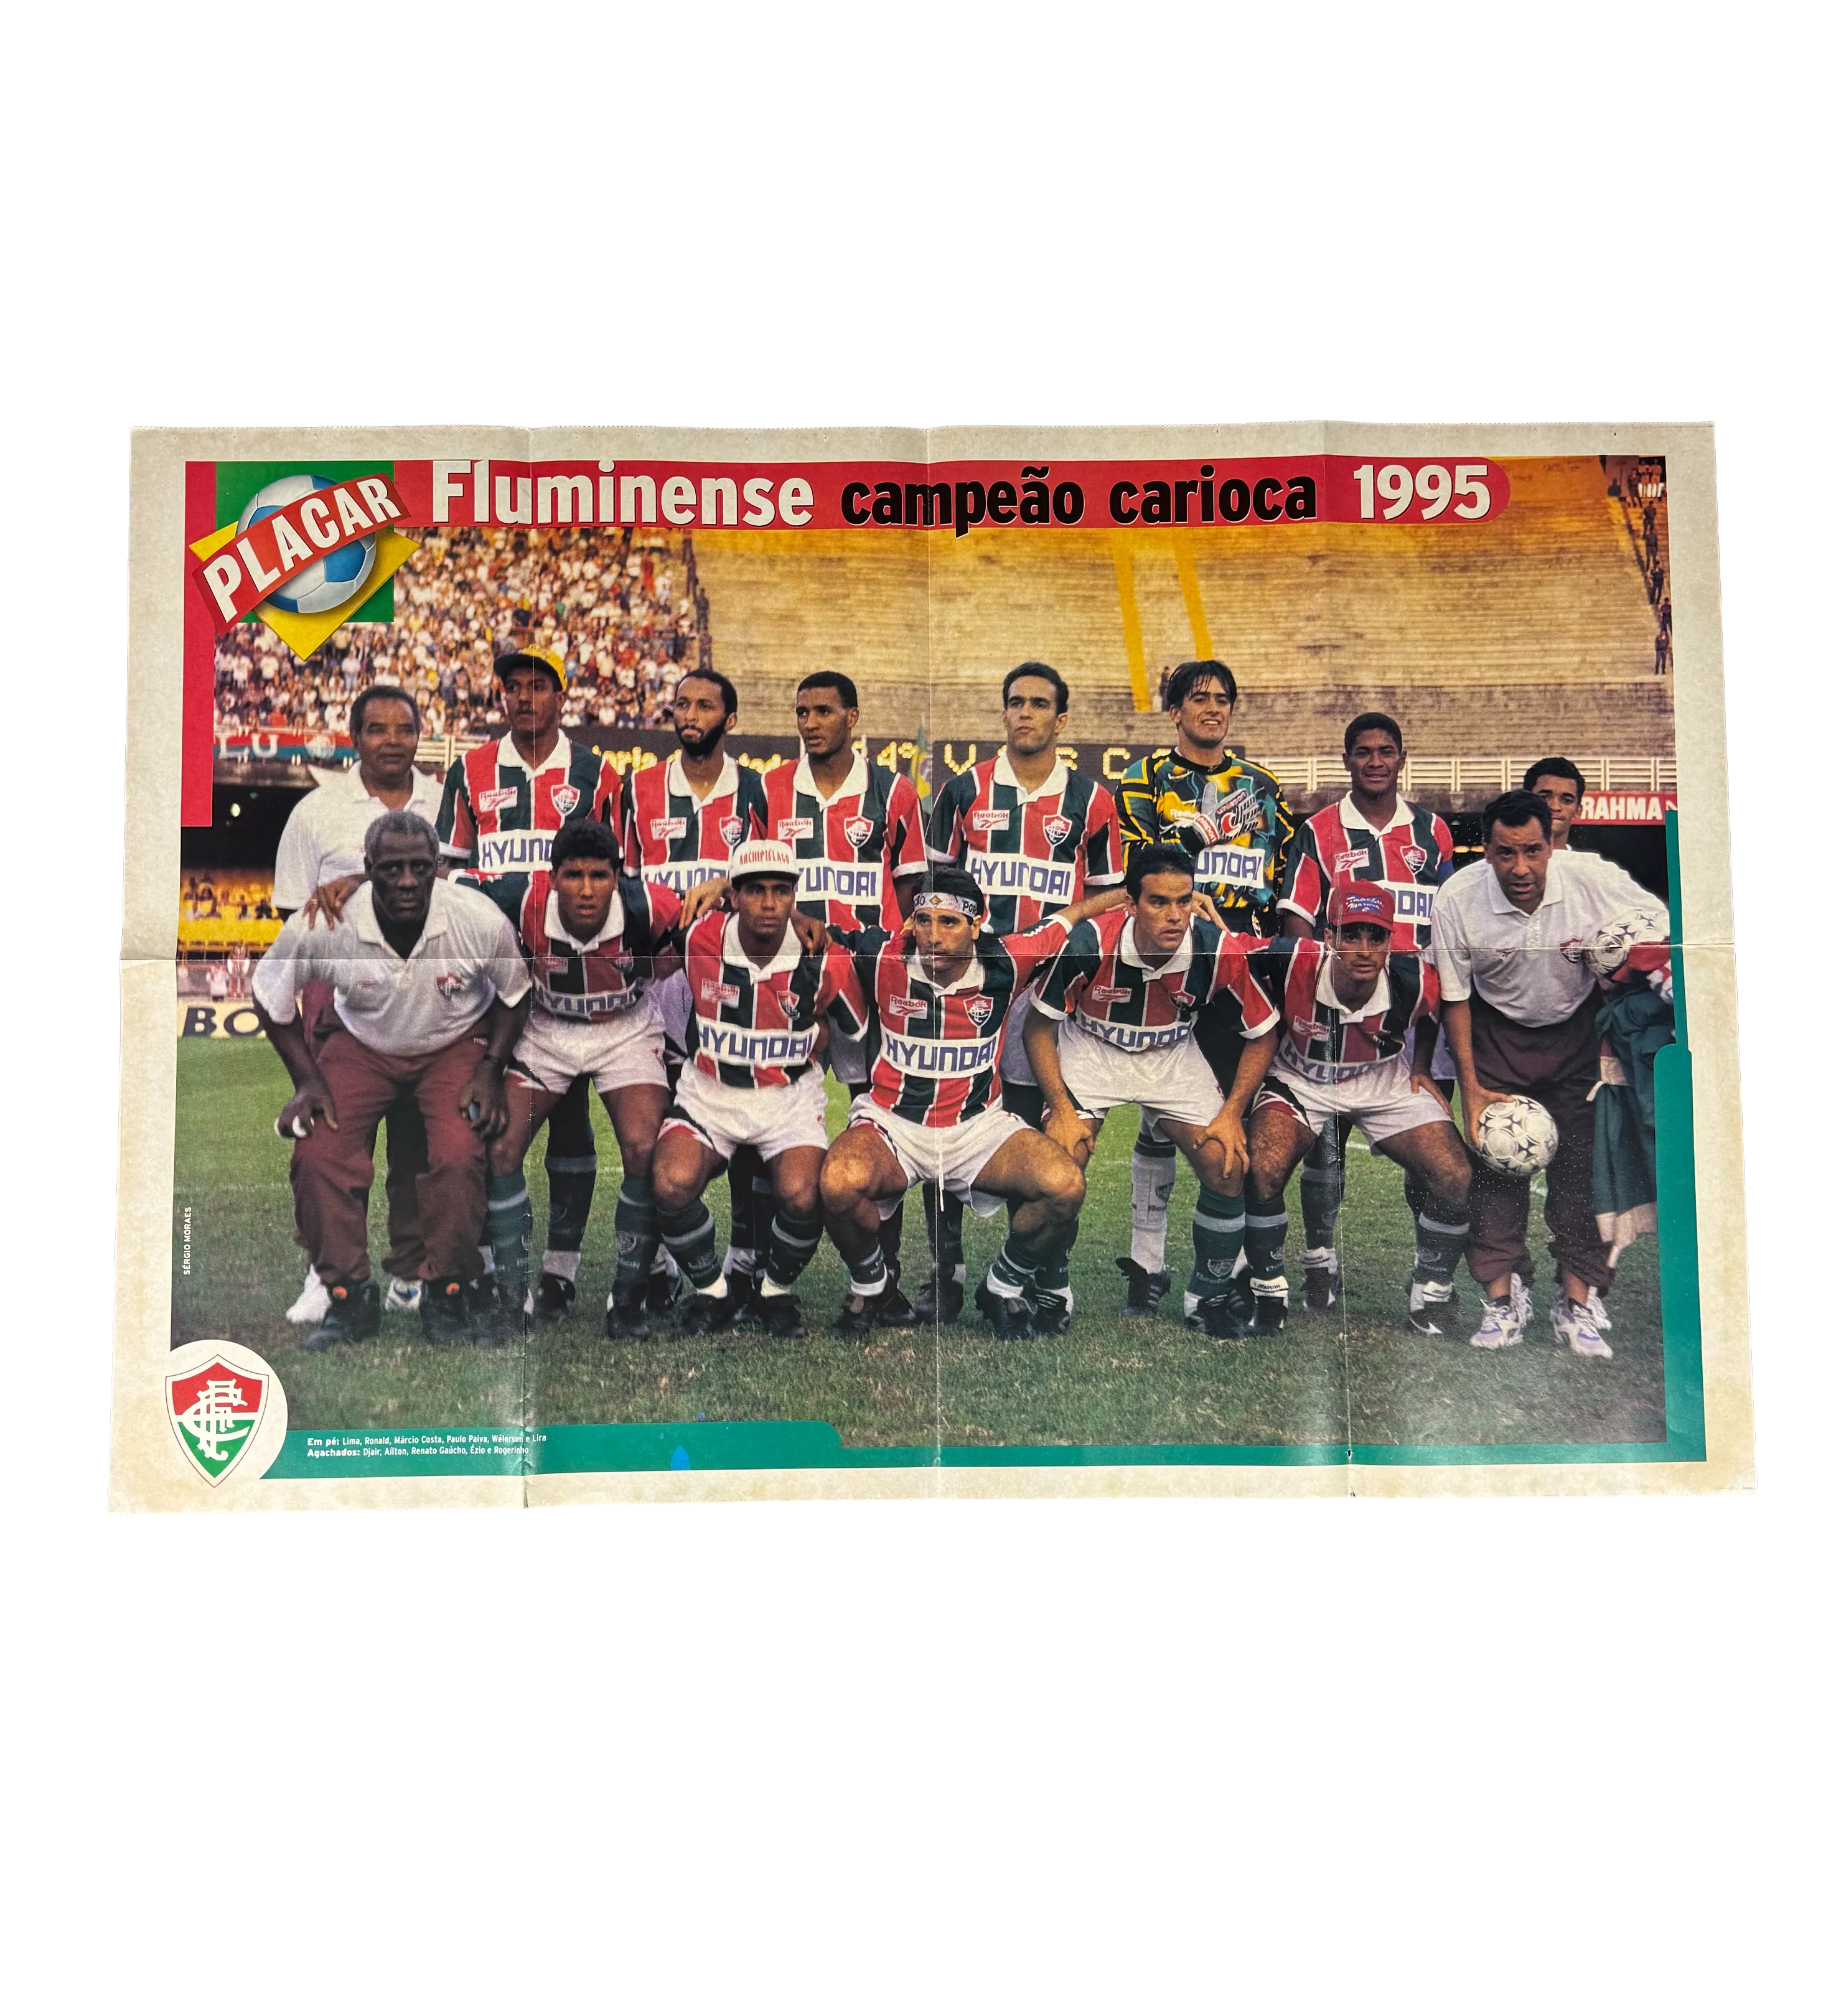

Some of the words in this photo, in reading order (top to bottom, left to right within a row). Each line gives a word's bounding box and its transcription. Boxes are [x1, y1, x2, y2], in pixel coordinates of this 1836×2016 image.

[433, 459, 814, 526] Fluminense
[841, 466, 1084, 538] campeão
[1109, 465, 1316, 525] carioca
[1353, 464, 1491, 520] 1995
[202, 478, 401, 622] PLACAR
[1580, 796, 1663, 820] RAHMA
[970, 857, 1071, 896] HYUNDAI
[891, 996, 927, 1008] Reebok
[886, 1032, 997, 1072] HYUNDAI
[184, 1207, 192, 1242] MORAES
[182, 1244, 191, 1276] SÉRGIO
[307, 1448, 360, 1458] Agachados:
[363, 1447, 382, 1457] Djair,
[411, 1446, 438, 1455] Renato
[439, 1445, 468, 1455] Gaúcho,
[471, 1444, 485, 1454] Ézio
[494, 1445, 529, 1455] Rogerinho
[326, 1437, 340, 1447] pé:
[343, 1437, 362, 1445] Lima,
[365, 1436, 391, 1445] Ronald,
[394, 1435, 419, 1444] Márcio
[421, 1435, 444, 1444] Costa,
[447, 1435, 466, 1443] Paulo
[469, 1434, 490, 1444] Paiva,
[492, 1434, 523, 1443] Wélerson
[532, 1434, 546, 1442] Lira
